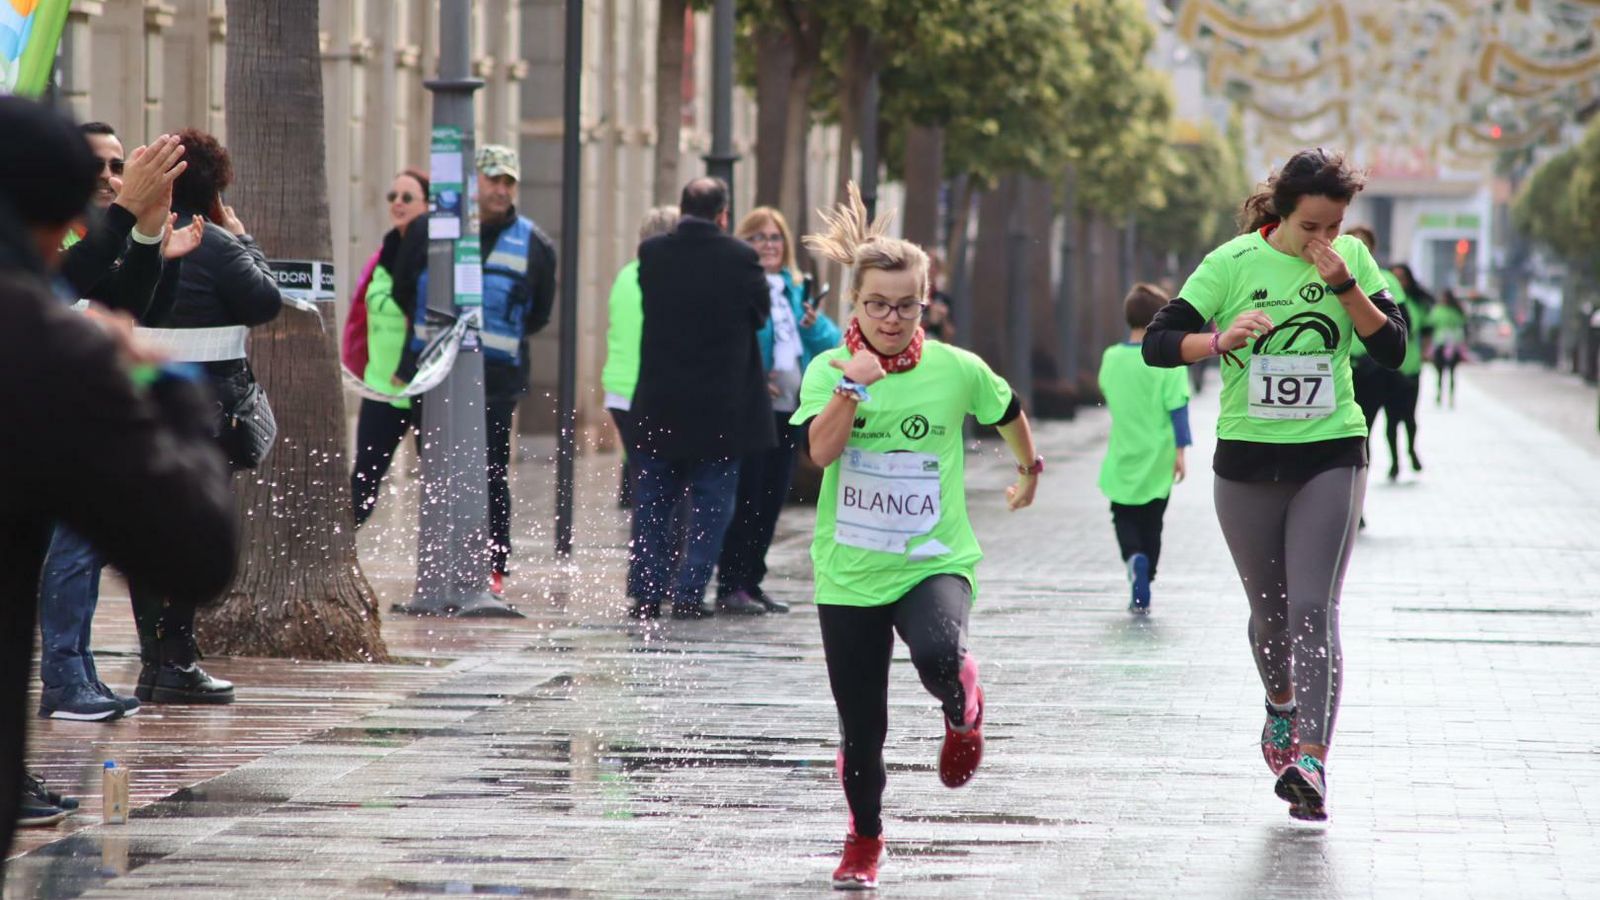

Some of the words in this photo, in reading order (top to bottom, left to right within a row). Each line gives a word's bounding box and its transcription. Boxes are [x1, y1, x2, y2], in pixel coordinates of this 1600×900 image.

[1254, 300, 1294, 309] IBERDROLA
[1261, 376, 1323, 405] 197
[843, 486, 935, 516] BLANCA
